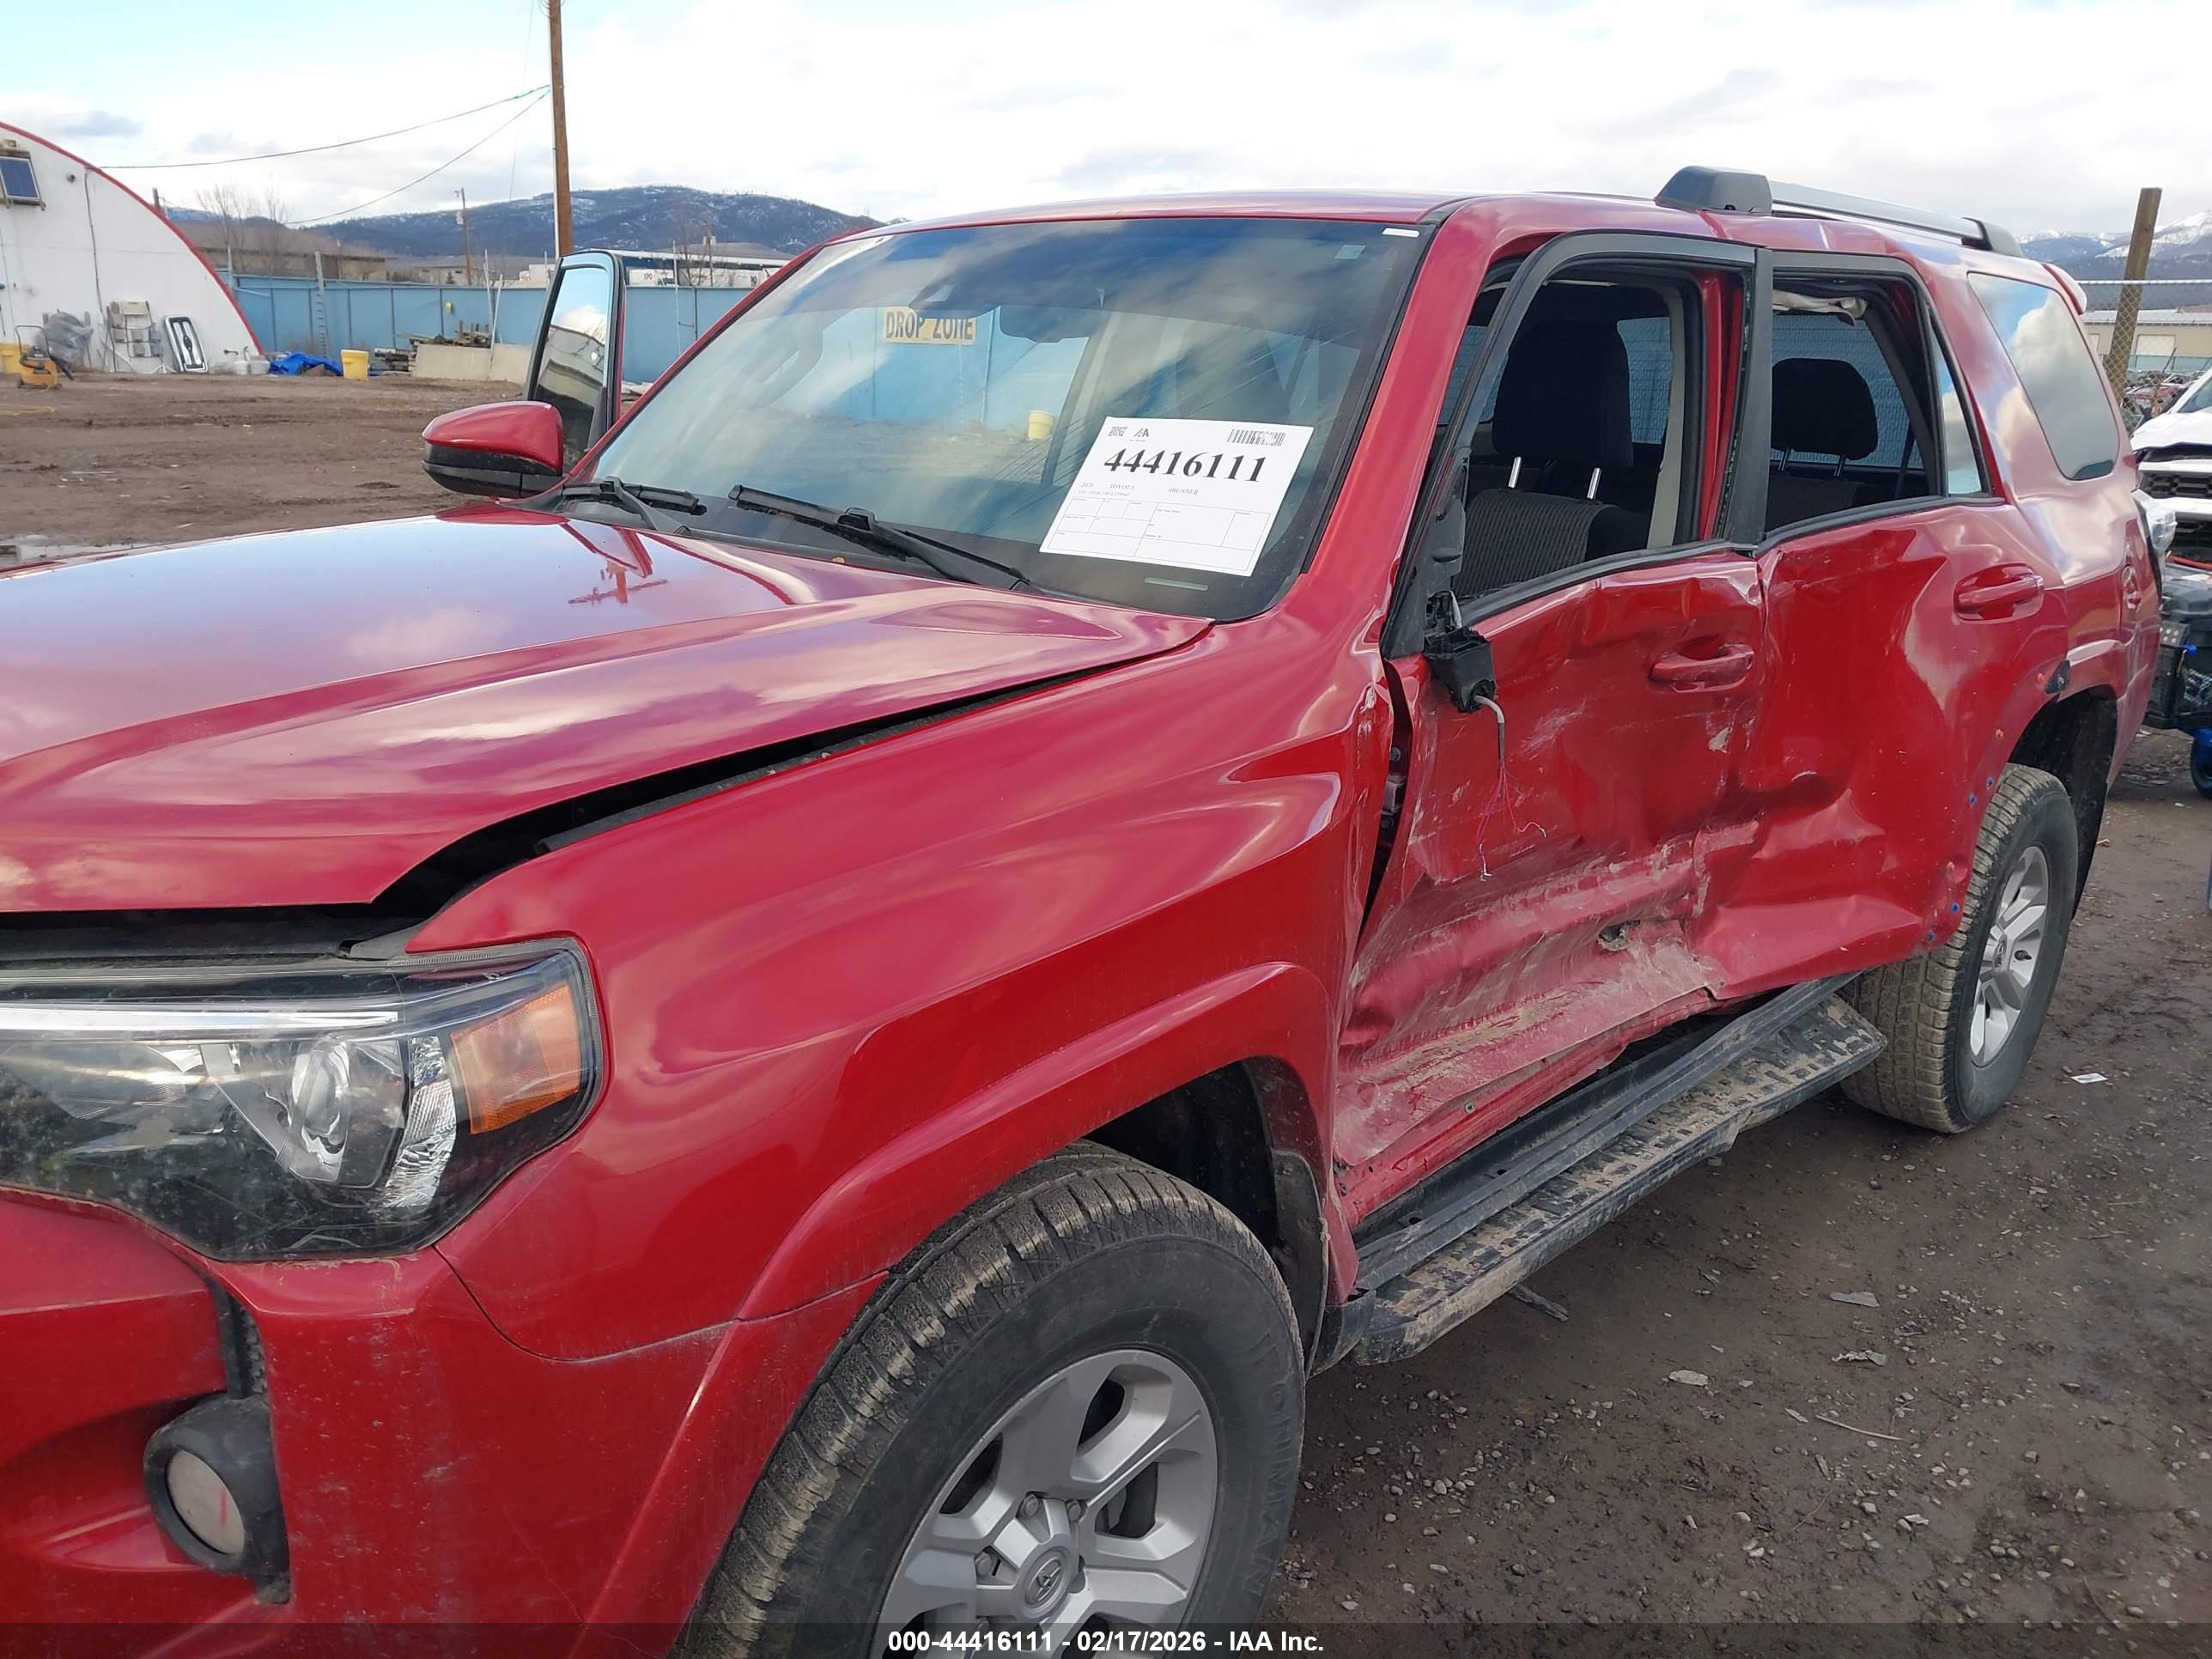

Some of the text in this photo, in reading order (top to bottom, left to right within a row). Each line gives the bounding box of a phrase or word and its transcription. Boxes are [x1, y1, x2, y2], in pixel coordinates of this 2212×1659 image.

[885, 310, 974, 340] DROP ZONE
[1103, 447, 1267, 483] 44416111
